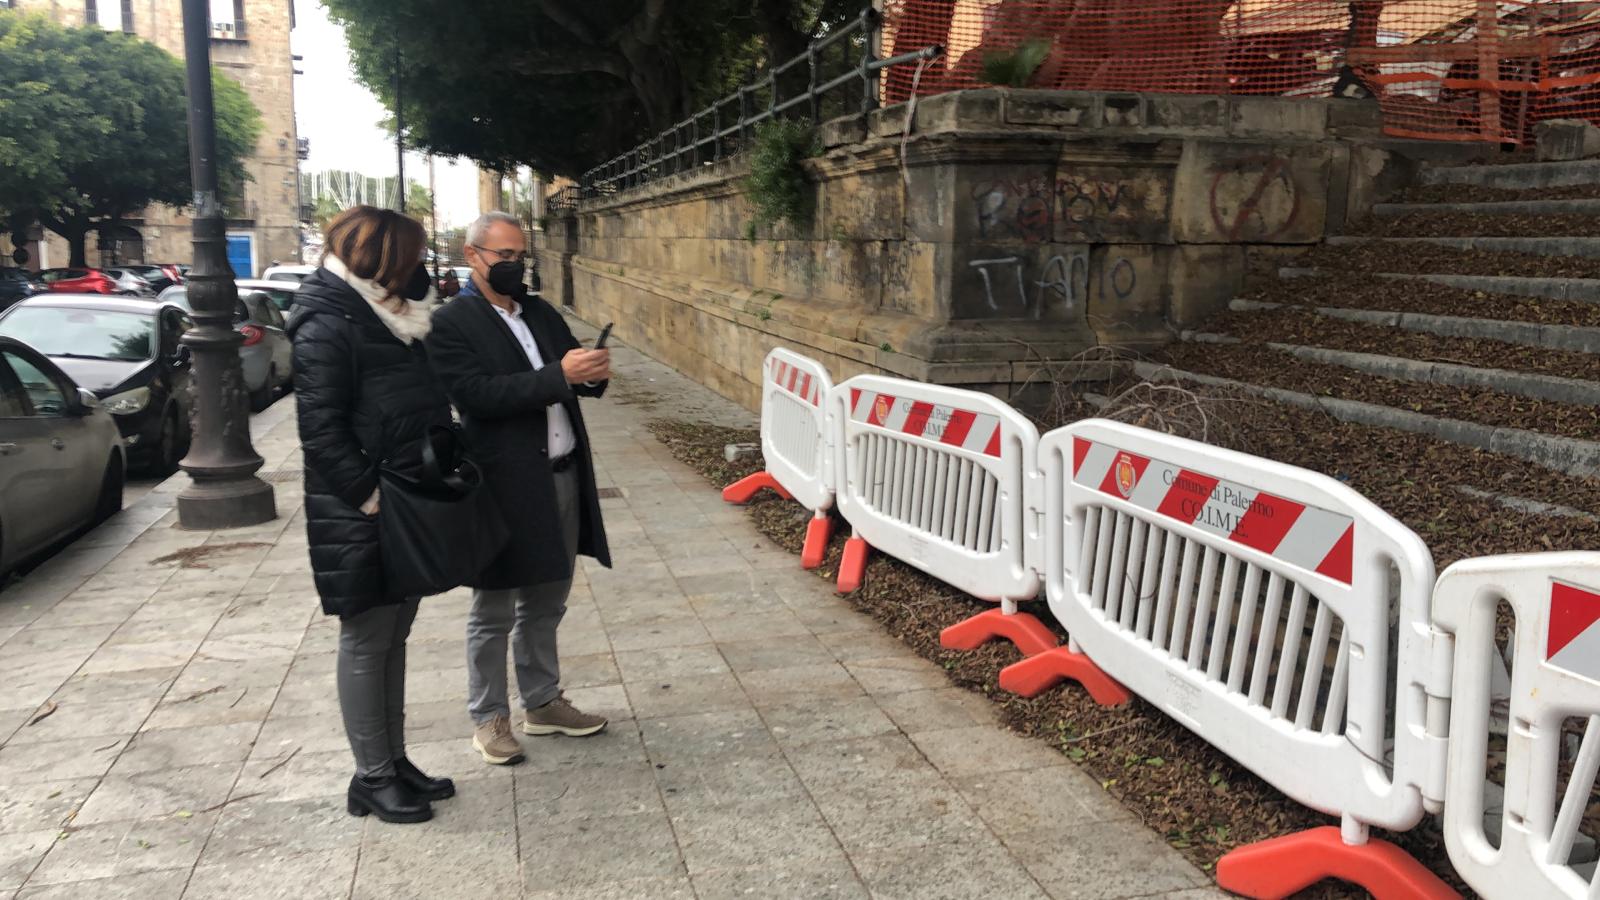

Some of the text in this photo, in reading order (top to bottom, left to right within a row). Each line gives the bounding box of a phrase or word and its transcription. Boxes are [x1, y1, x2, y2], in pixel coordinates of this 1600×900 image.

[1162, 469, 1274, 519] Comune di Palermo
[1180, 497, 1249, 539] CO.I.M.E.
